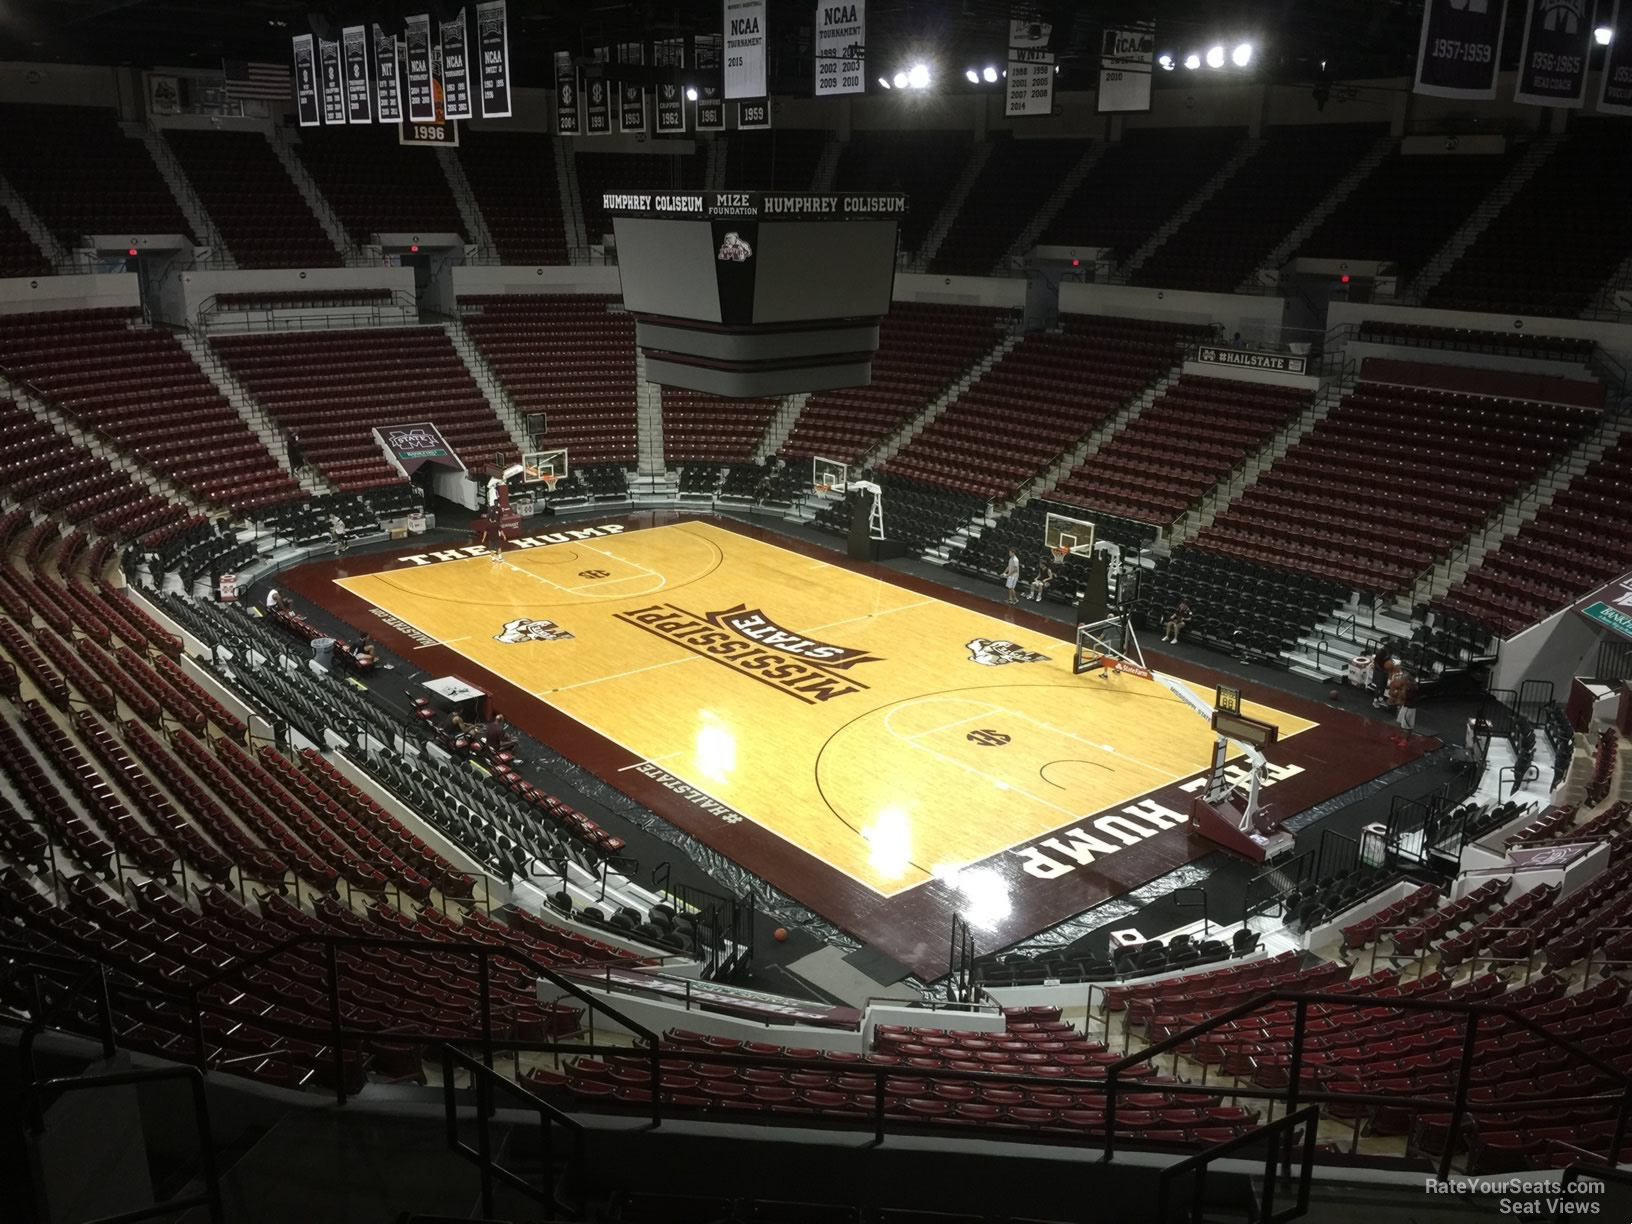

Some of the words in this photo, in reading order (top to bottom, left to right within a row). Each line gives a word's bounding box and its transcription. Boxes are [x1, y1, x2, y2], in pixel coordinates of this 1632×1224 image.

[824, 4, 857, 26] NCAA
[731, 17, 759, 36] NCAA
[819, 26, 861, 39] TOURNAMENT
[727, 37, 762, 48] TOURNAMENT
[484, 50, 502, 64] NCAA
[1432, 38, 1491, 63] 1957-1959
[411, 60, 427, 73] NCAA
[446, 54, 463, 68] NCAA
[728, 57, 743, 67] 2015
[820, 63, 837, 74] 2002
[842, 60, 860, 73] 2003
[820, 78, 837, 89] 2009
[842, 75, 859, 88] 2010
[1106, 72, 1123, 81] 2010
[662, 112, 679, 125] 1962
[701, 110, 717, 122] 1961
[744, 107, 764, 121] 1959
[414, 126, 444, 140] 1996
[603, 194, 651, 211] HUMPHREY
[655, 196, 703, 212] COLISEUM
[717, 194, 750, 207] MIZE
[764, 197, 837, 213] HUMPHREY
[844, 197, 905, 212] COLISEUM
[709, 207, 758, 215] FOUNDATION
[1219, 352, 1284, 369] #HAILSTATE
[399, 545, 492, 566] THE
[508, 524, 625, 549] HUMP
[731, 615, 844, 659] STATE
[623, 605, 860, 702] MISSISSIPPI
[636, 764, 743, 824] #HAILSTATE
[1010, 799, 1189, 880] HUMP
